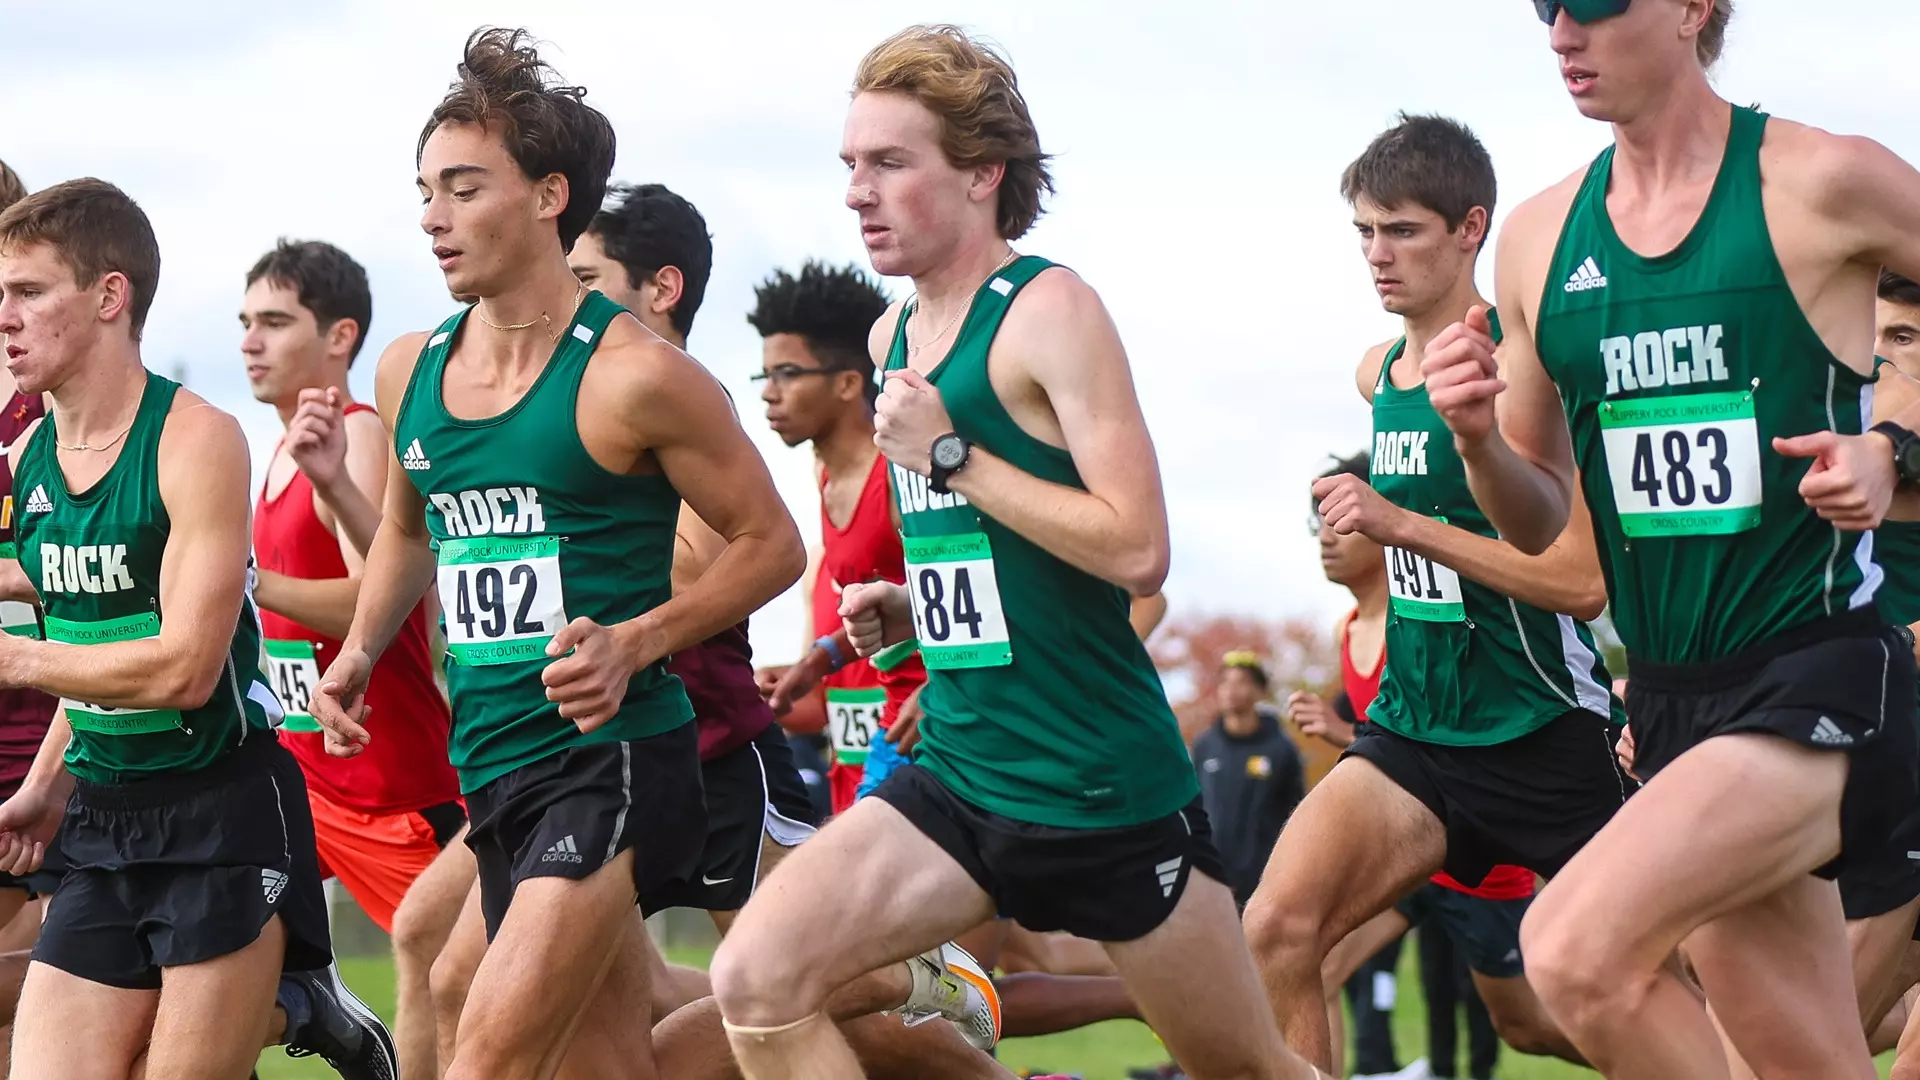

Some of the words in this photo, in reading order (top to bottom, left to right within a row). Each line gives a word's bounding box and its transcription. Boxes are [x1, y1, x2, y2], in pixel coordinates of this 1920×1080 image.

[1564, 275, 1607, 292] adidas
[1600, 324, 1729, 395] ROCK
[1611, 408, 1650, 421] SLIPPERY
[1654, 406, 1678, 418] ROCK
[1680, 402, 1741, 416] UNIVERSITY
[1372, 431, 1429, 475] ROCK
[403, 459, 431, 470] adidas
[1631, 427, 1732, 507] 483
[26, 502, 53, 513] adidas
[429, 486, 546, 537] ROCK
[1650, 517, 1679, 529] CROSS
[1681, 515, 1724, 528] COUNTRY
[468, 546, 492, 558] ROCK
[494, 540, 548, 556] UNIVERSITY
[40, 542, 134, 594] ROCK
[1393, 547, 1443, 599] 491
[457, 564, 545, 638] 492
[908, 568, 982, 641] 84
[51, 625, 73, 637] SLIPPERY
[74, 630, 94, 640] ROCK
[94, 622, 150, 640] UNIVERSITY
[467, 647, 490, 660] CROSS
[491, 643, 537, 658] COUNTRY
[937, 650, 979, 662] COUNTRY
[87, 716, 107, 729] CROSS
[106, 717, 148, 729] COUNTRY
[542, 851, 583, 864] adidas
[267, 873, 289, 904] adidas
